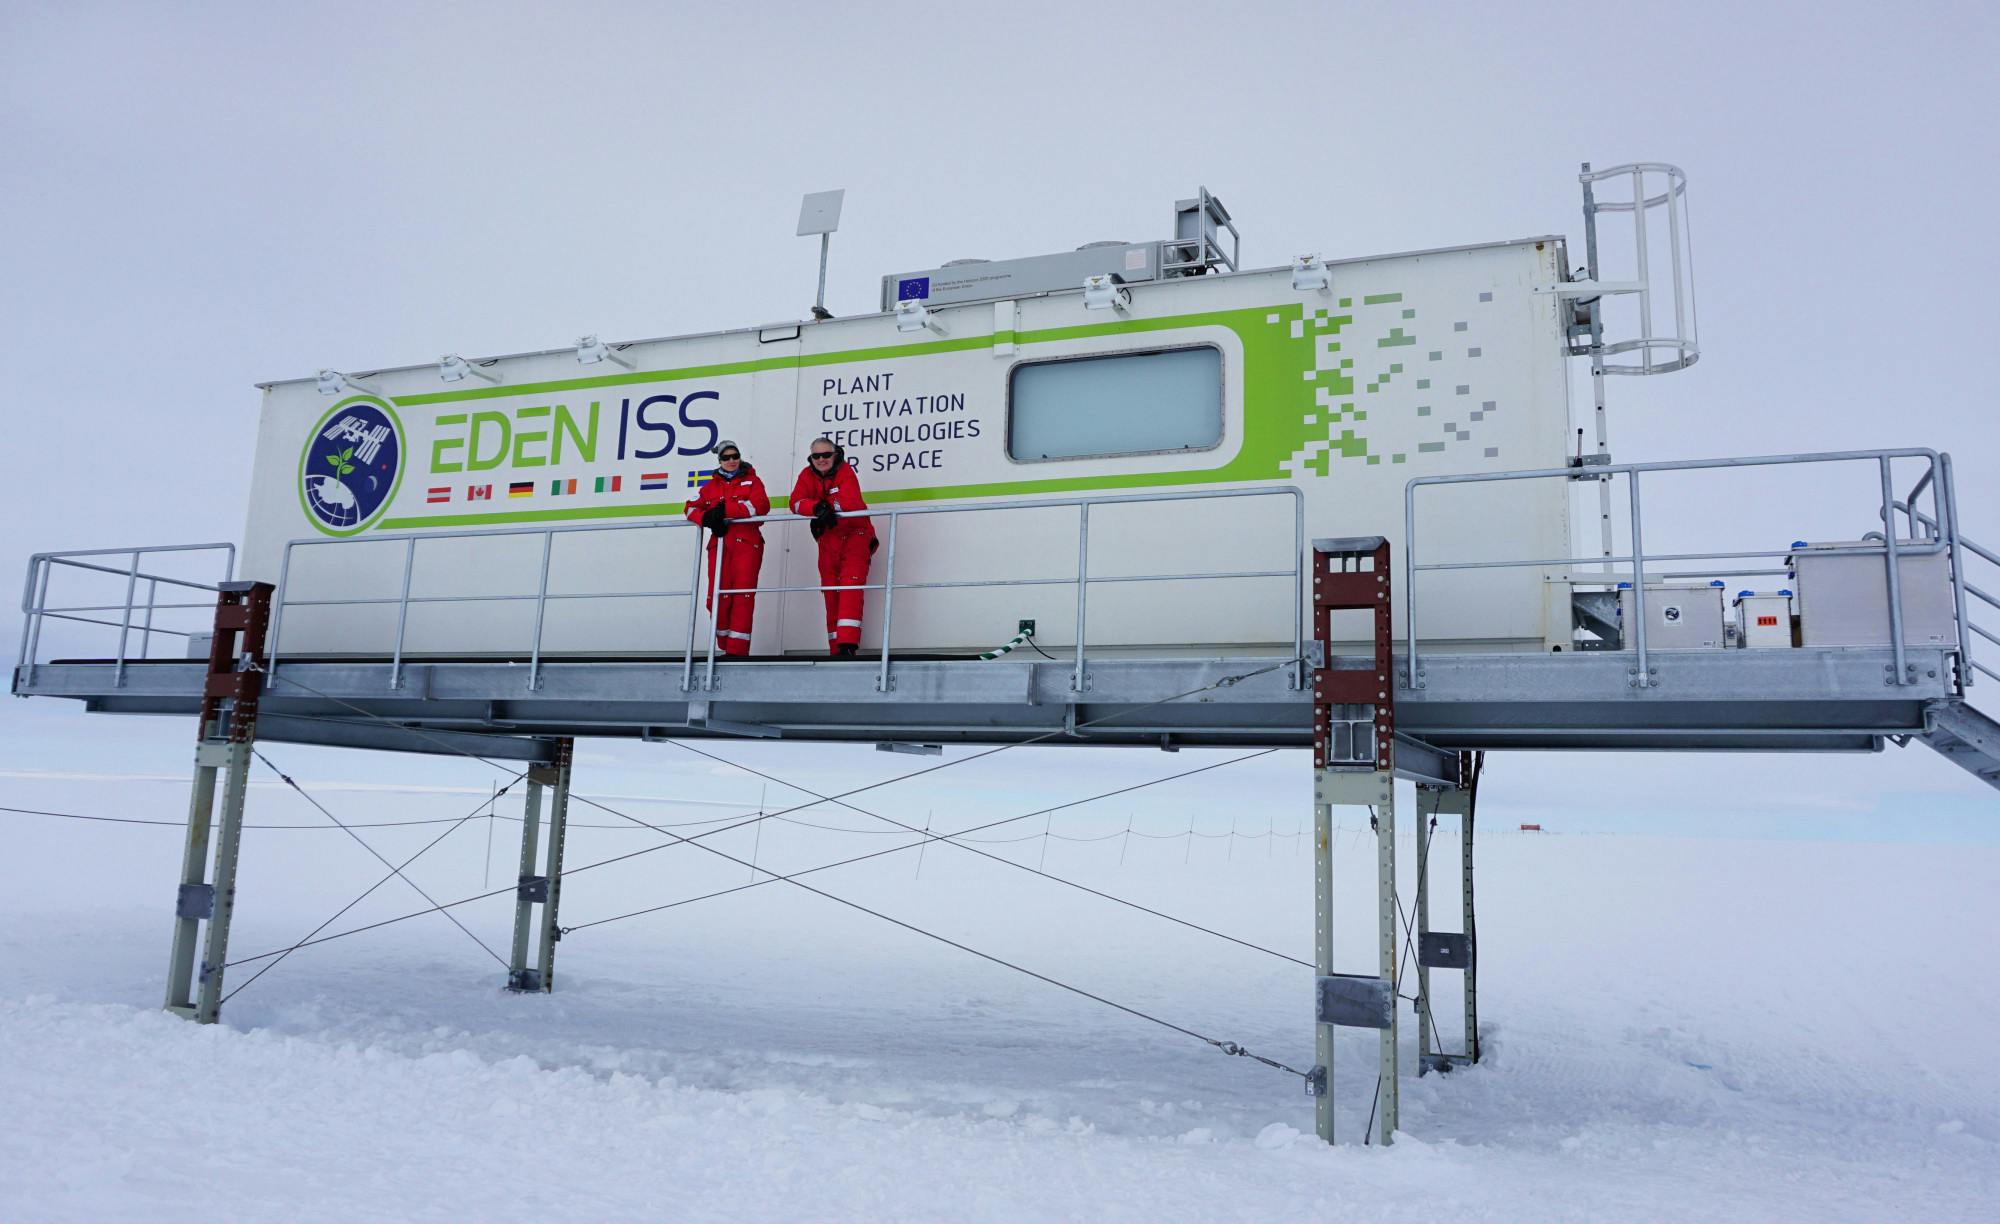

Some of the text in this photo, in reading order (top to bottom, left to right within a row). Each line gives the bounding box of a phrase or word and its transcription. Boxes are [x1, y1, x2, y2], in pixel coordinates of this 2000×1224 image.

[823, 373, 894, 396] PLANT
[821, 393, 965, 423] CULTIVATION
[430, 391, 719, 474] EDEN ISS
[821, 419, 981, 448] TECHNOLOGIES
[872, 449, 943, 472] SPACE
